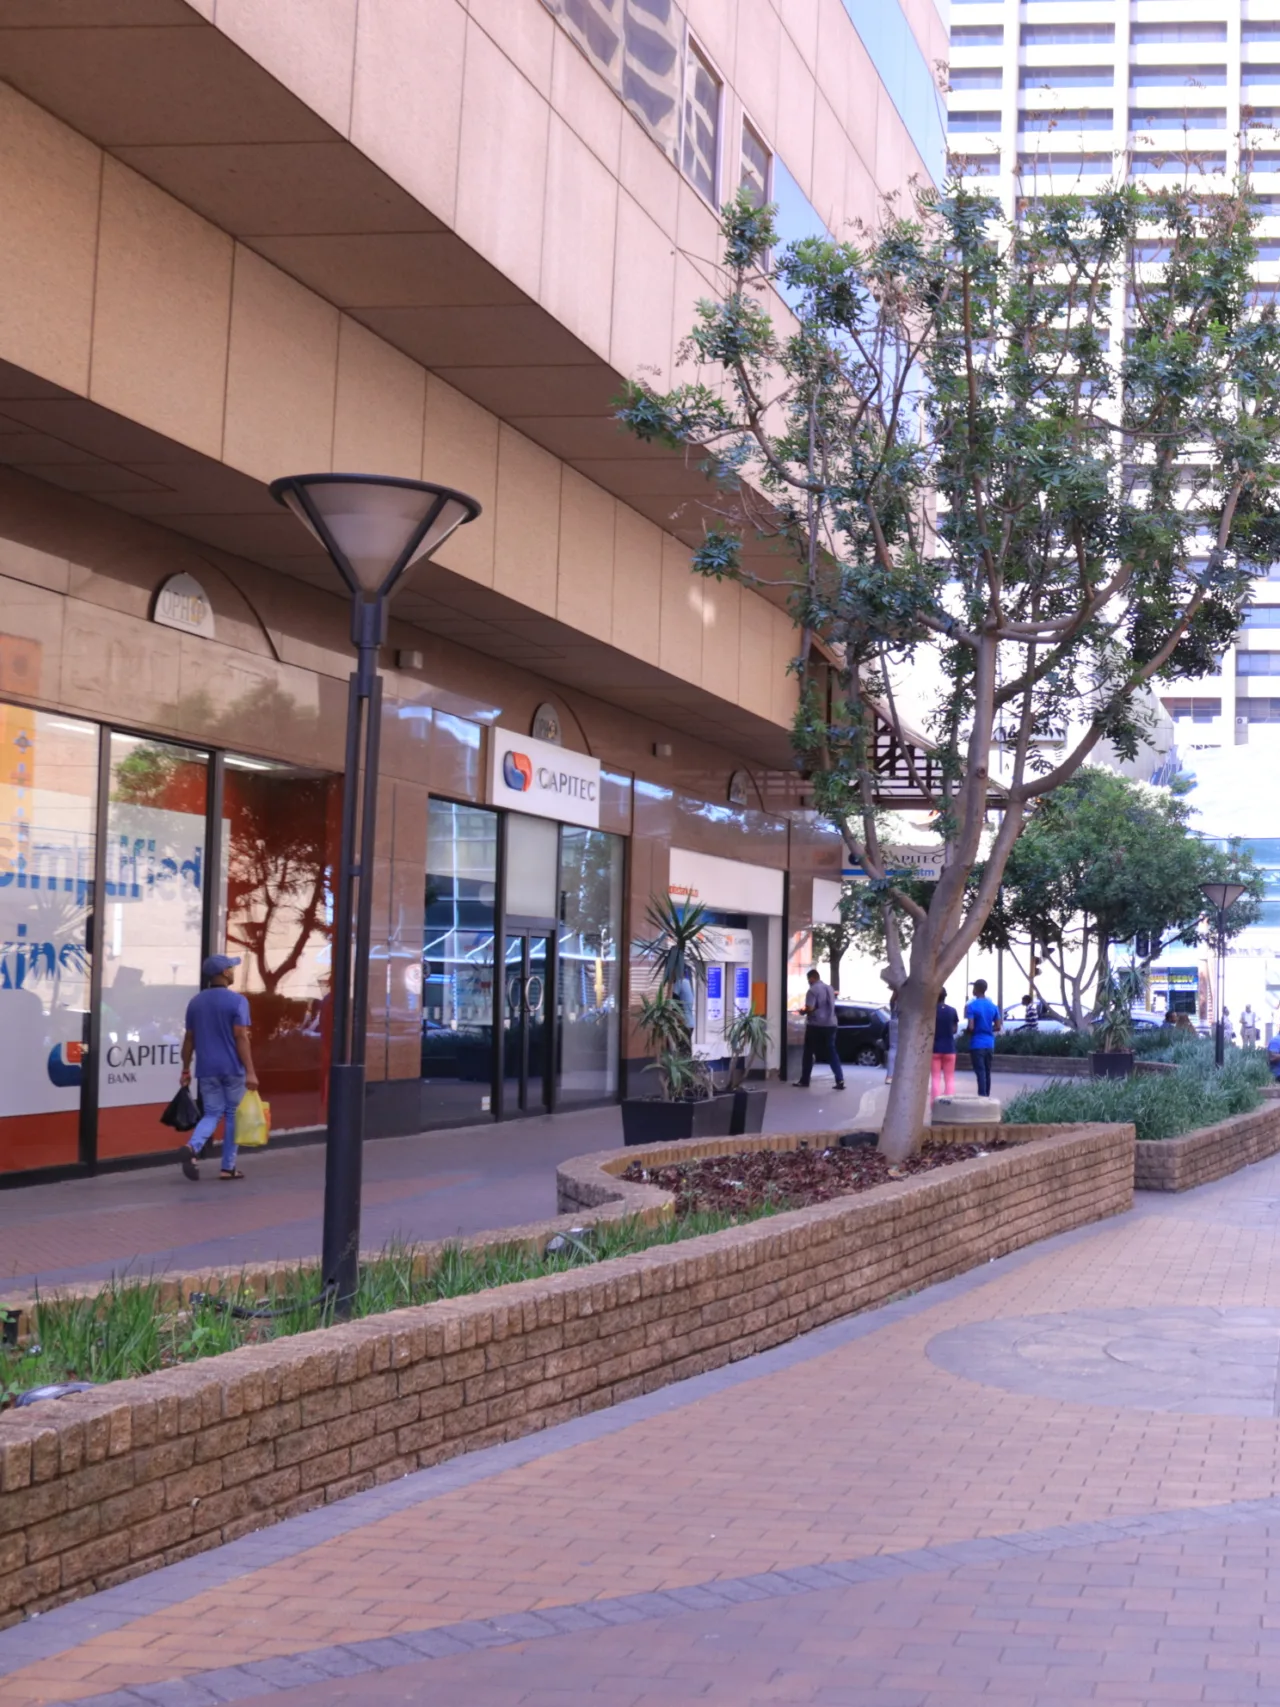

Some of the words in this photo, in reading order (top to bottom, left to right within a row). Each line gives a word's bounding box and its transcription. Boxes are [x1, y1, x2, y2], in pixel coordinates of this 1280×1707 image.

[536, 766, 597, 802] CAPITEC
[106, 1043, 180, 1068] CAPITE
[107, 1072, 137, 1085] BANK
